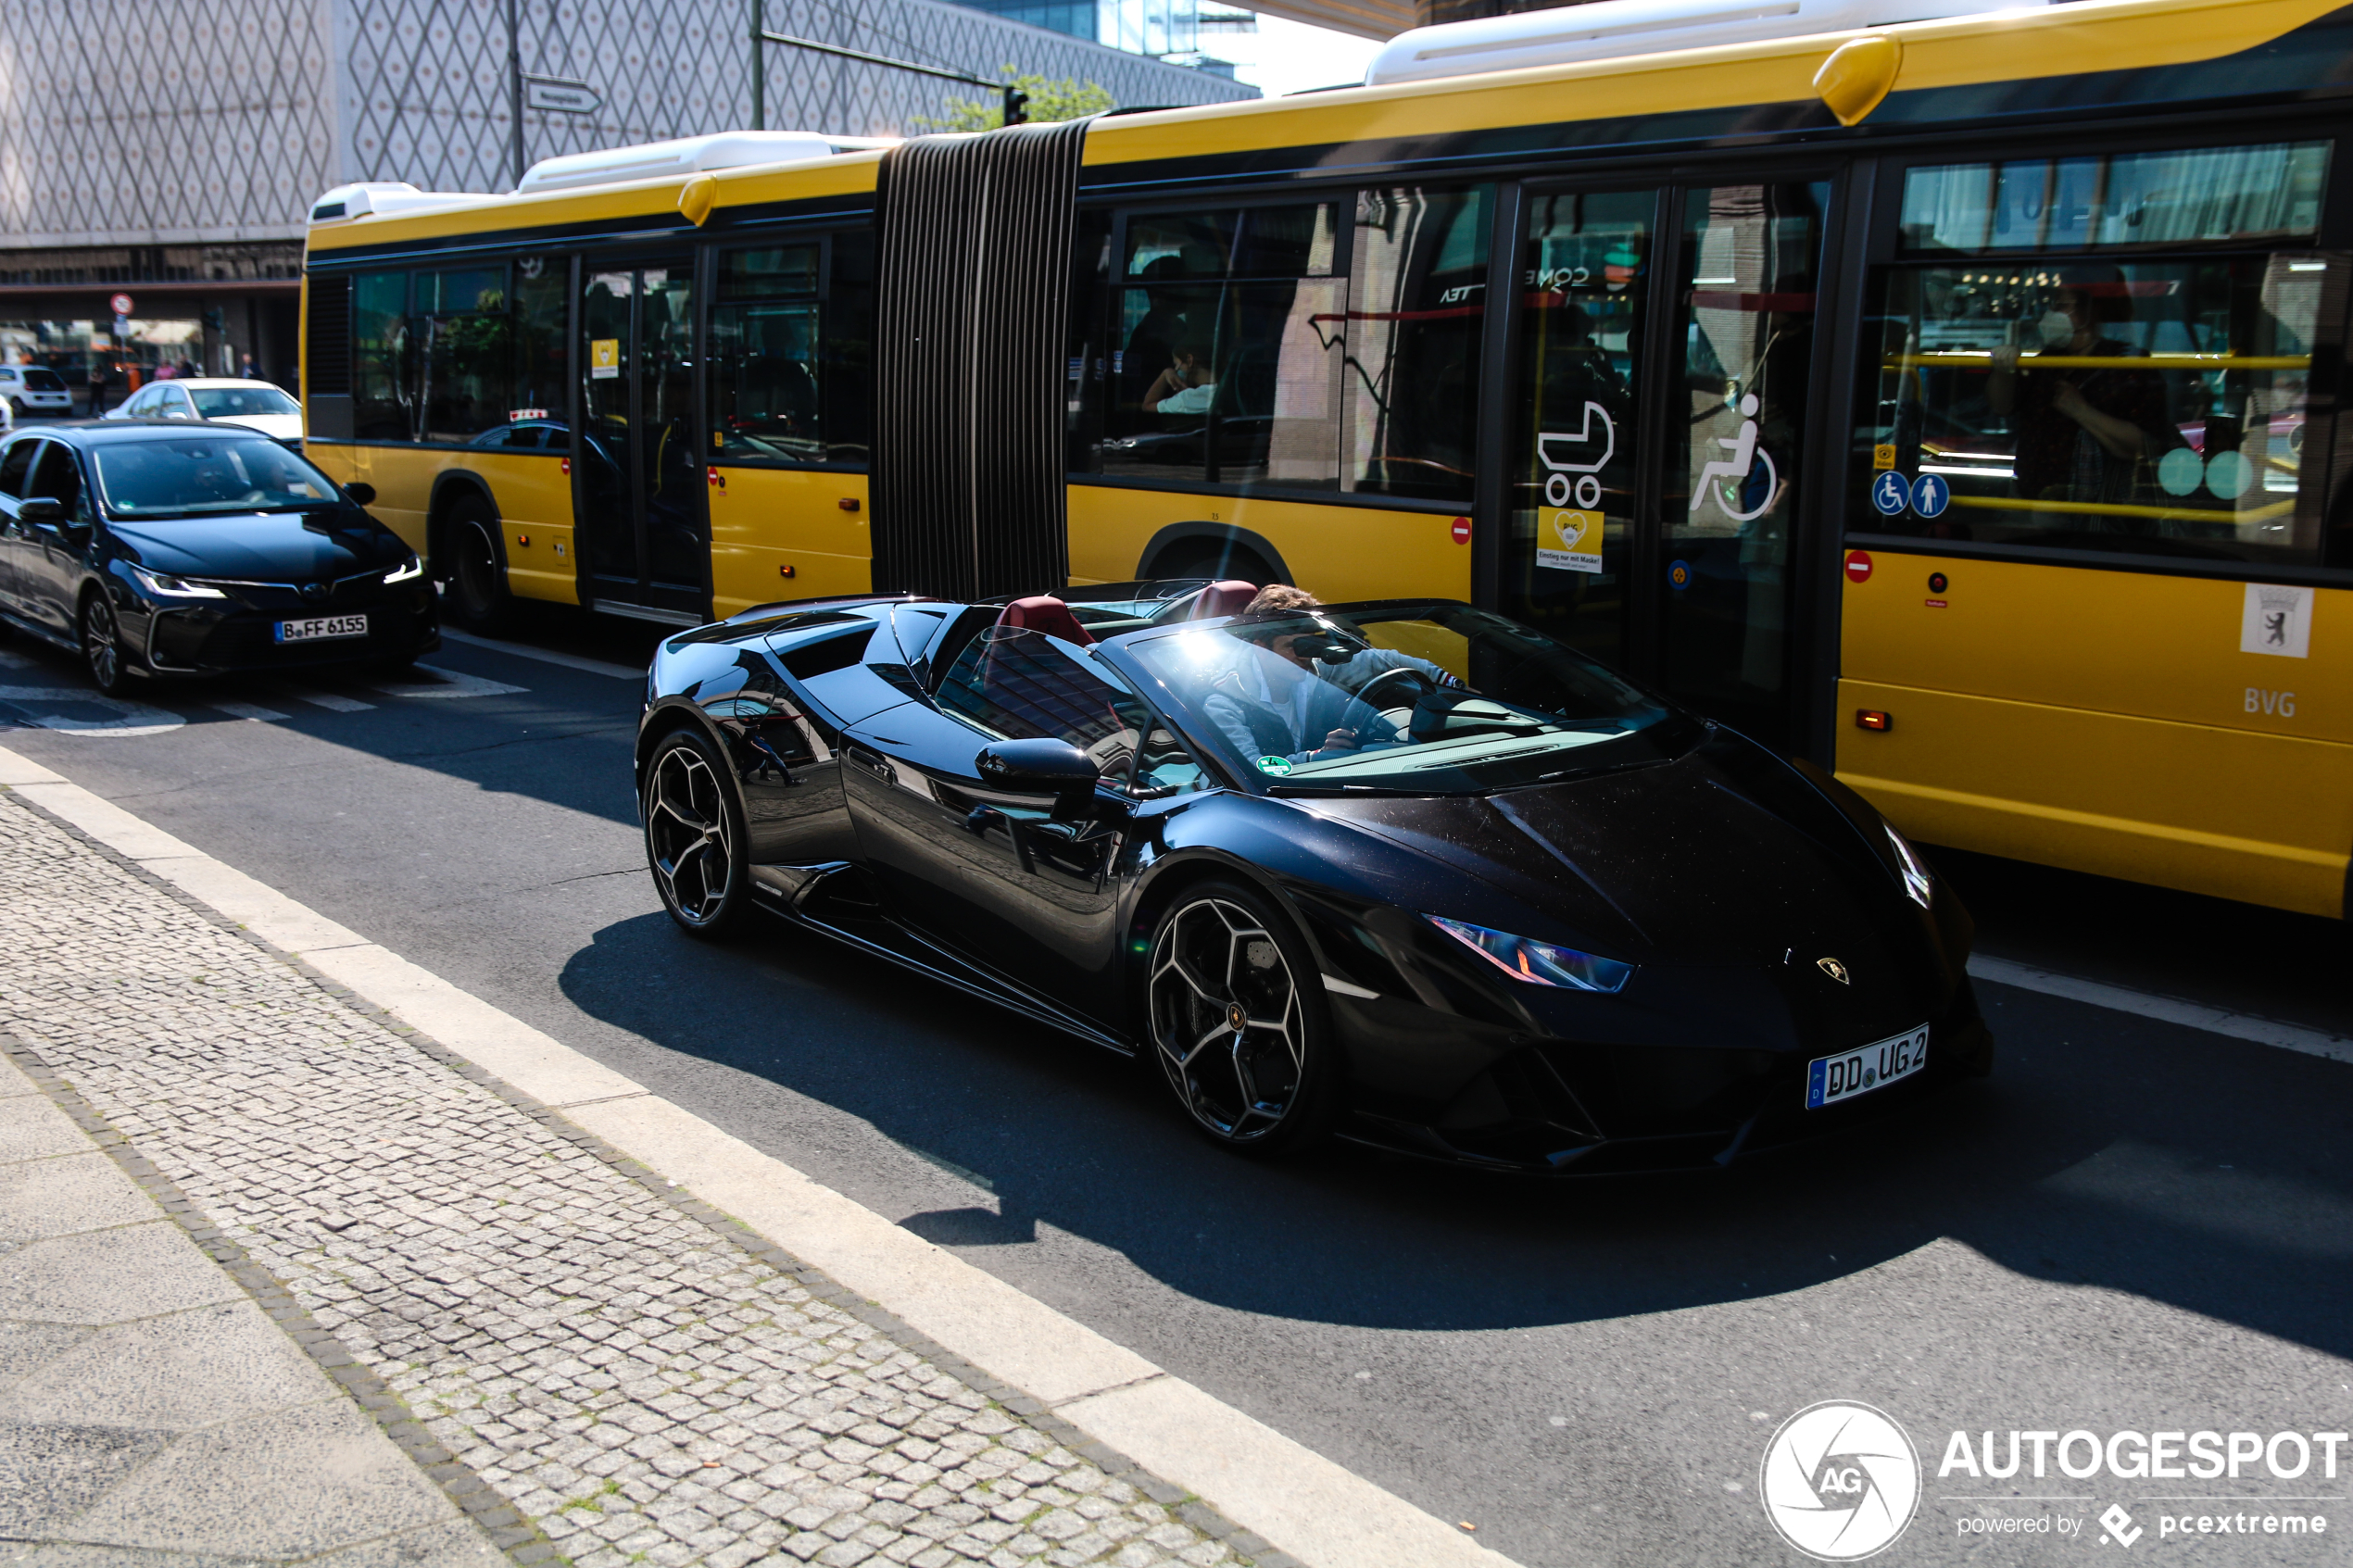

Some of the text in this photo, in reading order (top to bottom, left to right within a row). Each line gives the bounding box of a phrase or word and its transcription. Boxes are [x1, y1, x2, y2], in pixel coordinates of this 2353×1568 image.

[1539, 551, 1559, 560] Einstieg
[1580, 556, 1600, 564] Maske!
[283, 623, 295, 638] B
[304, 621, 324, 636] FF
[327, 617, 365, 634] 6155
[2245, 687, 2296, 718] BVG
[1268, 758, 1277, 766] 4
[1827, 1056, 1862, 1098] DD
[1879, 1039, 1909, 1080] UG
[1912, 1031, 1927, 1067] 2
